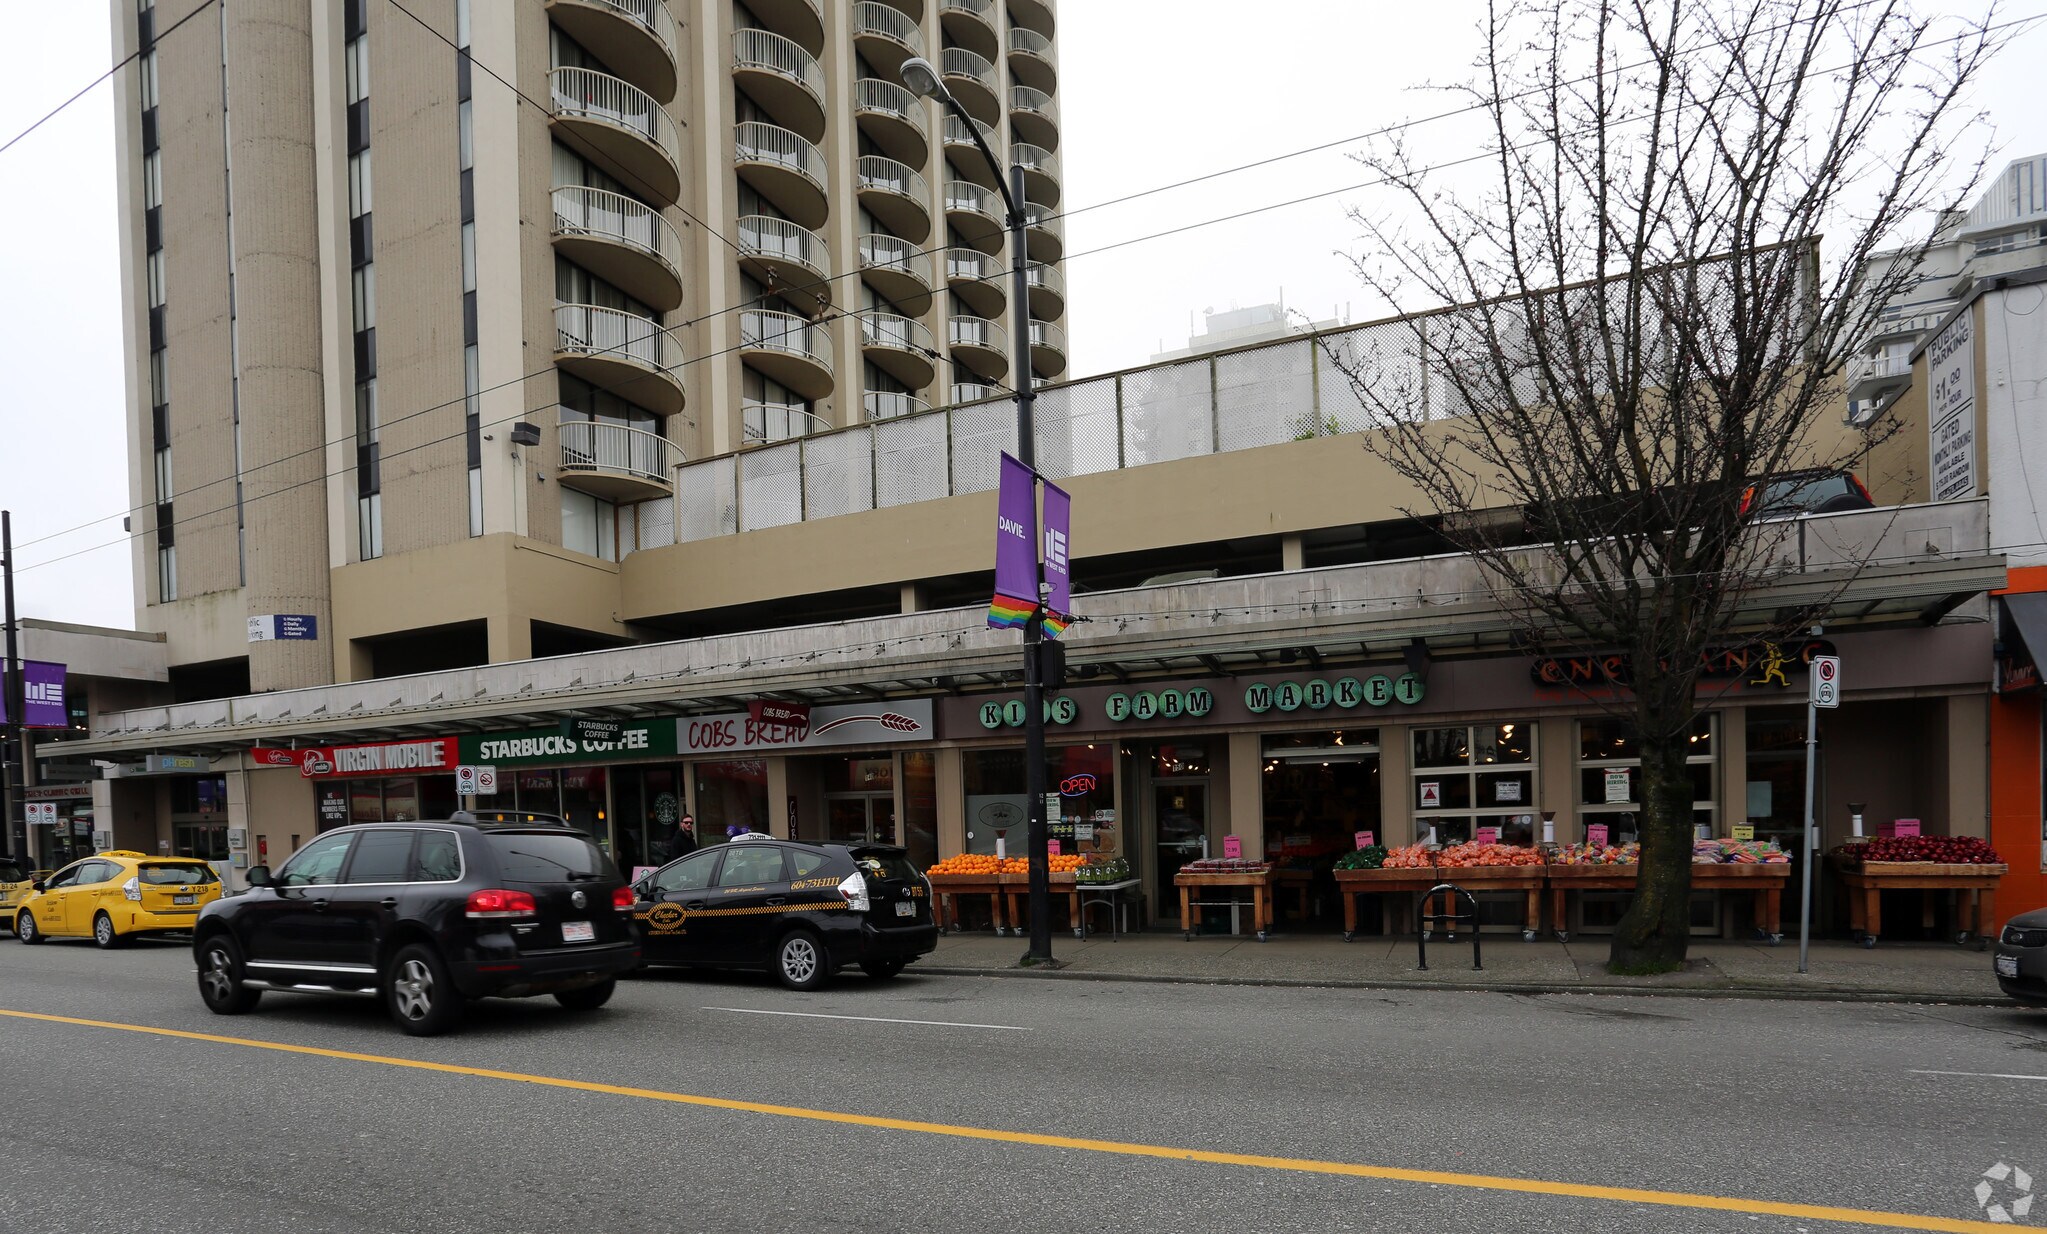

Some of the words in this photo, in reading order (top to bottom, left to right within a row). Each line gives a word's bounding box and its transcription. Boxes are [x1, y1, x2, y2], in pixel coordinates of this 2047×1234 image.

[1931, 314, 1966, 357] PUBLIC
[1932, 328, 1968, 372] PARKING
[1949, 390, 1962, 408] HOUR
[1941, 418, 1960, 444] GATED
[1951, 430, 1971, 454] PARKING
[1939, 452, 1964, 475] AVAILABLE
[1000, 516, 1026, 540] DAVIE.
[763, 706, 775, 717] COBS
[984, 700, 1070, 724] KI'S
[1113, 691, 1209, 717] FARM
[1250, 678, 1415, 708] MARKET
[578, 721, 618, 732] STARBUCKS
[584, 730, 610, 739] COFFEE
[688, 719, 736, 749] COBS
[744, 718, 810, 746] BREAD
[334, 746, 382, 772] VIRGIN
[385, 741, 446, 770] MOBILE
[480, 736, 577, 760] STARBUCKS
[162, 757, 194, 769] pHresh
[1060, 778, 1096, 792] OPEN
